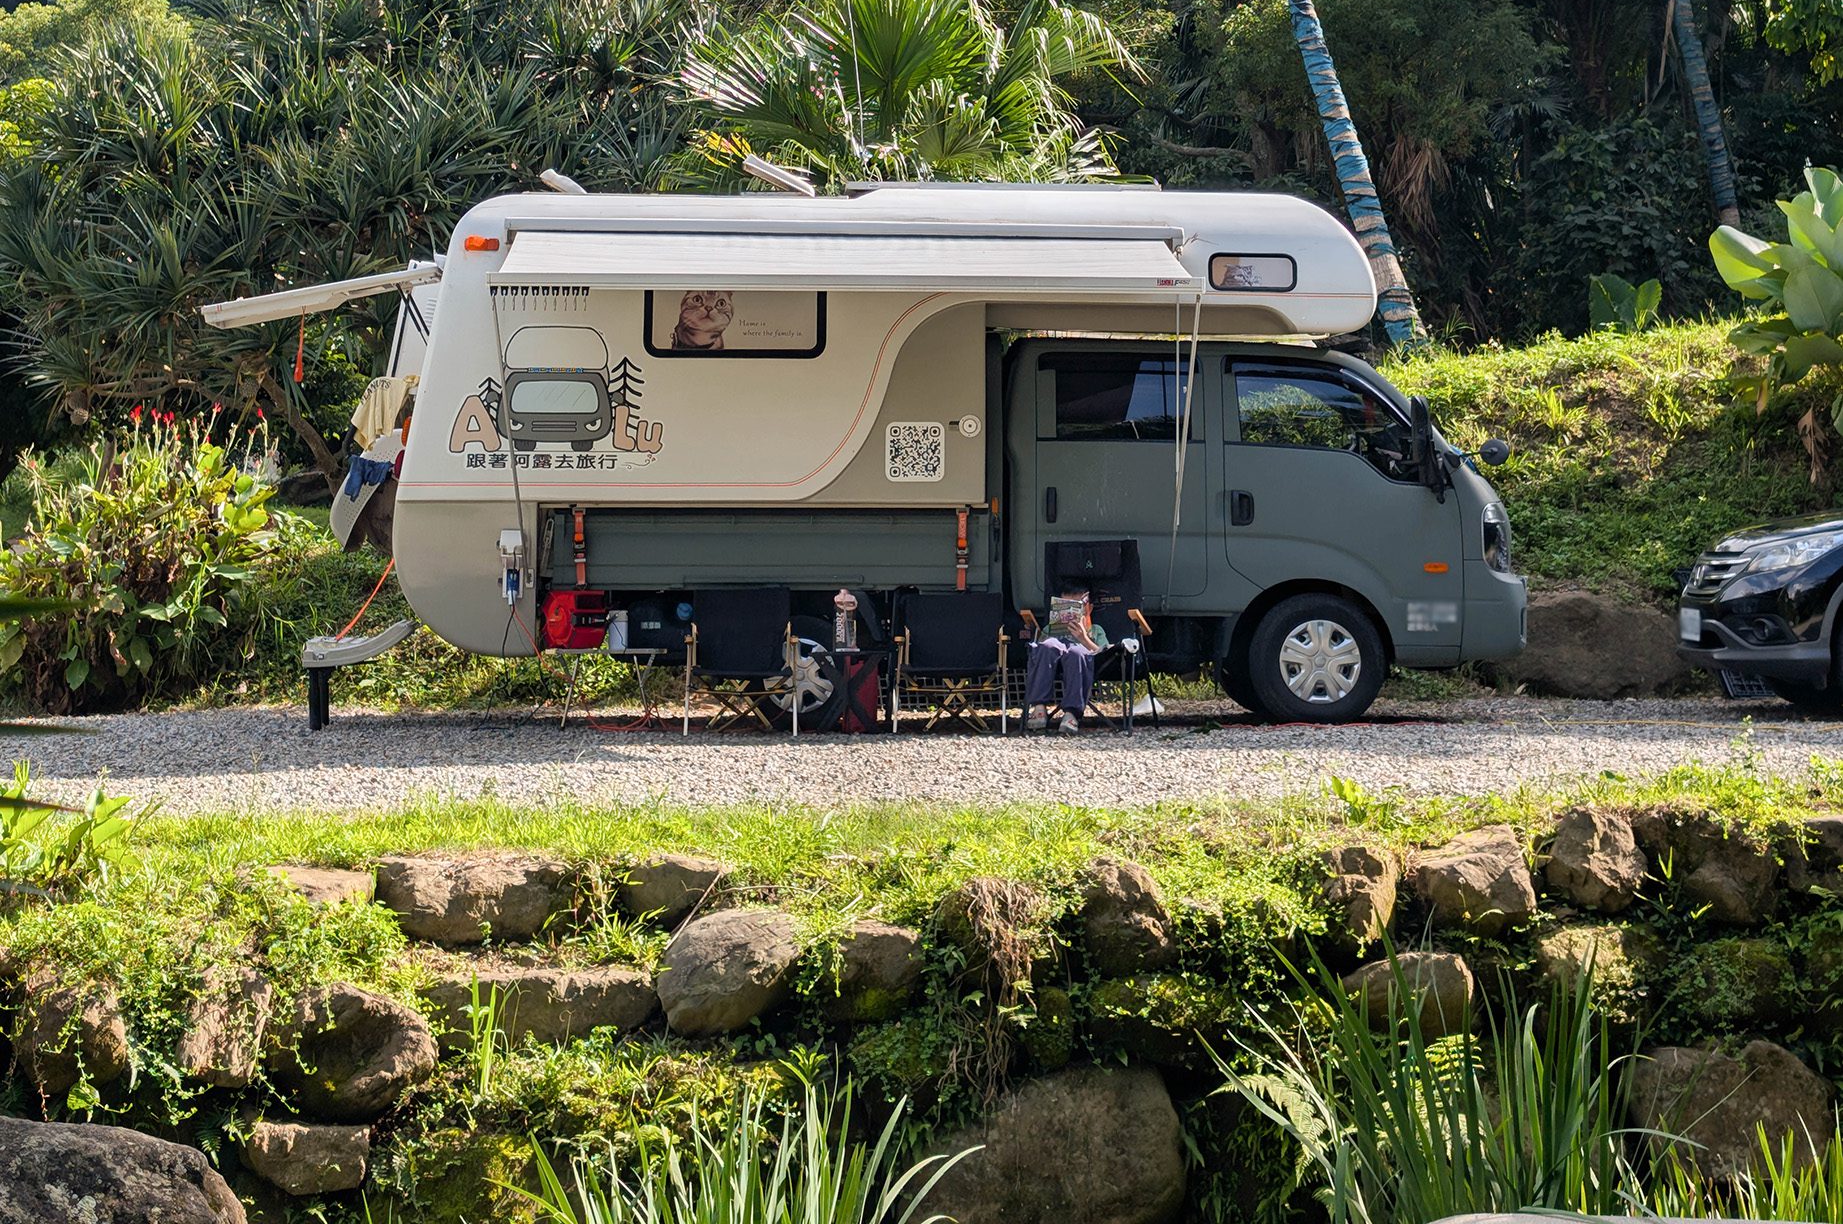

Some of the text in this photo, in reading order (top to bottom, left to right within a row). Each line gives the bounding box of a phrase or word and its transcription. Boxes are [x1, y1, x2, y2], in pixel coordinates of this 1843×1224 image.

[739, 319, 759, 327] Home
[773, 329, 794, 338] family
[361, 379, 391, 406] PEANUTS
[449, 394, 502, 453] A
[466, 453, 619, 469] 跟著阿露去旅行
